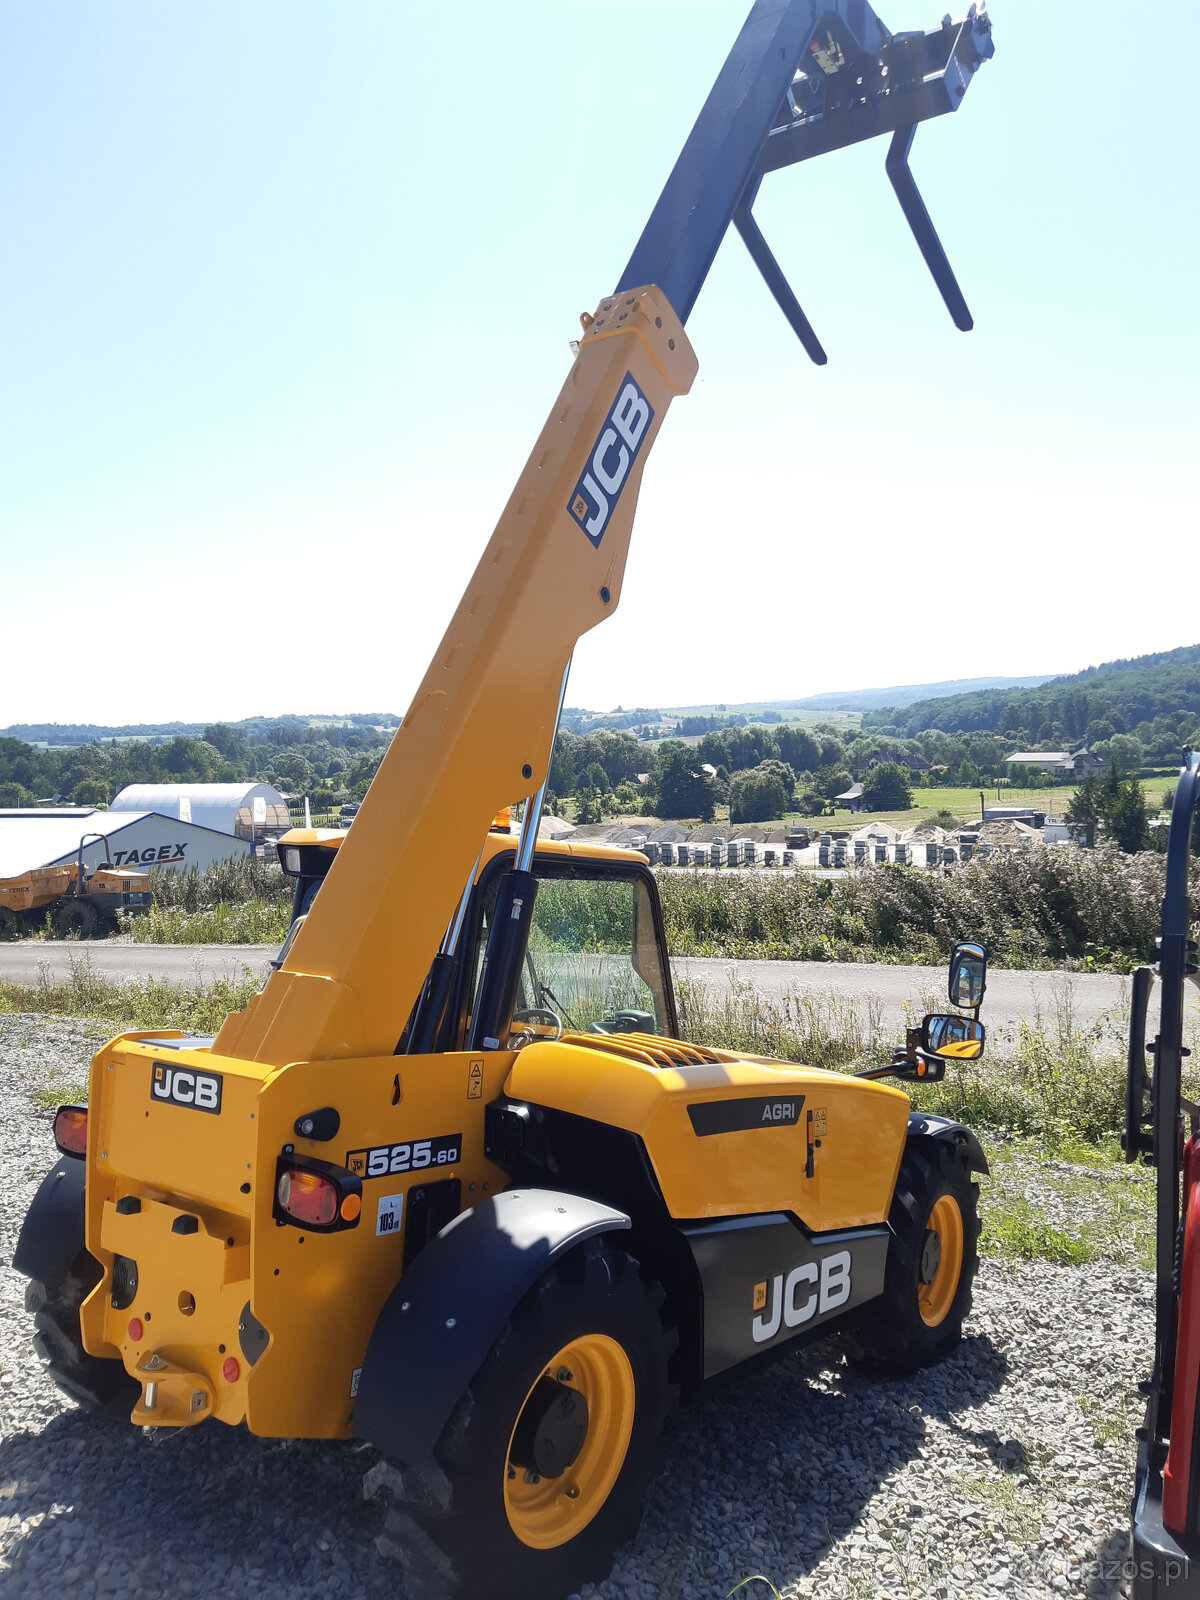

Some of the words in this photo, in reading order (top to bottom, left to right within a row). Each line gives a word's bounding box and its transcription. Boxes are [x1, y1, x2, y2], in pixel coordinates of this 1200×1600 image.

[583, 383, 649, 537] JCB
[113, 843, 188, 866] TAGEX
[154, 1069, 218, 1109] JCB
[762, 1103, 795, 1120] AGRI
[380, 1212, 394, 1232] 103
[752, 1250, 851, 1343] JCB
